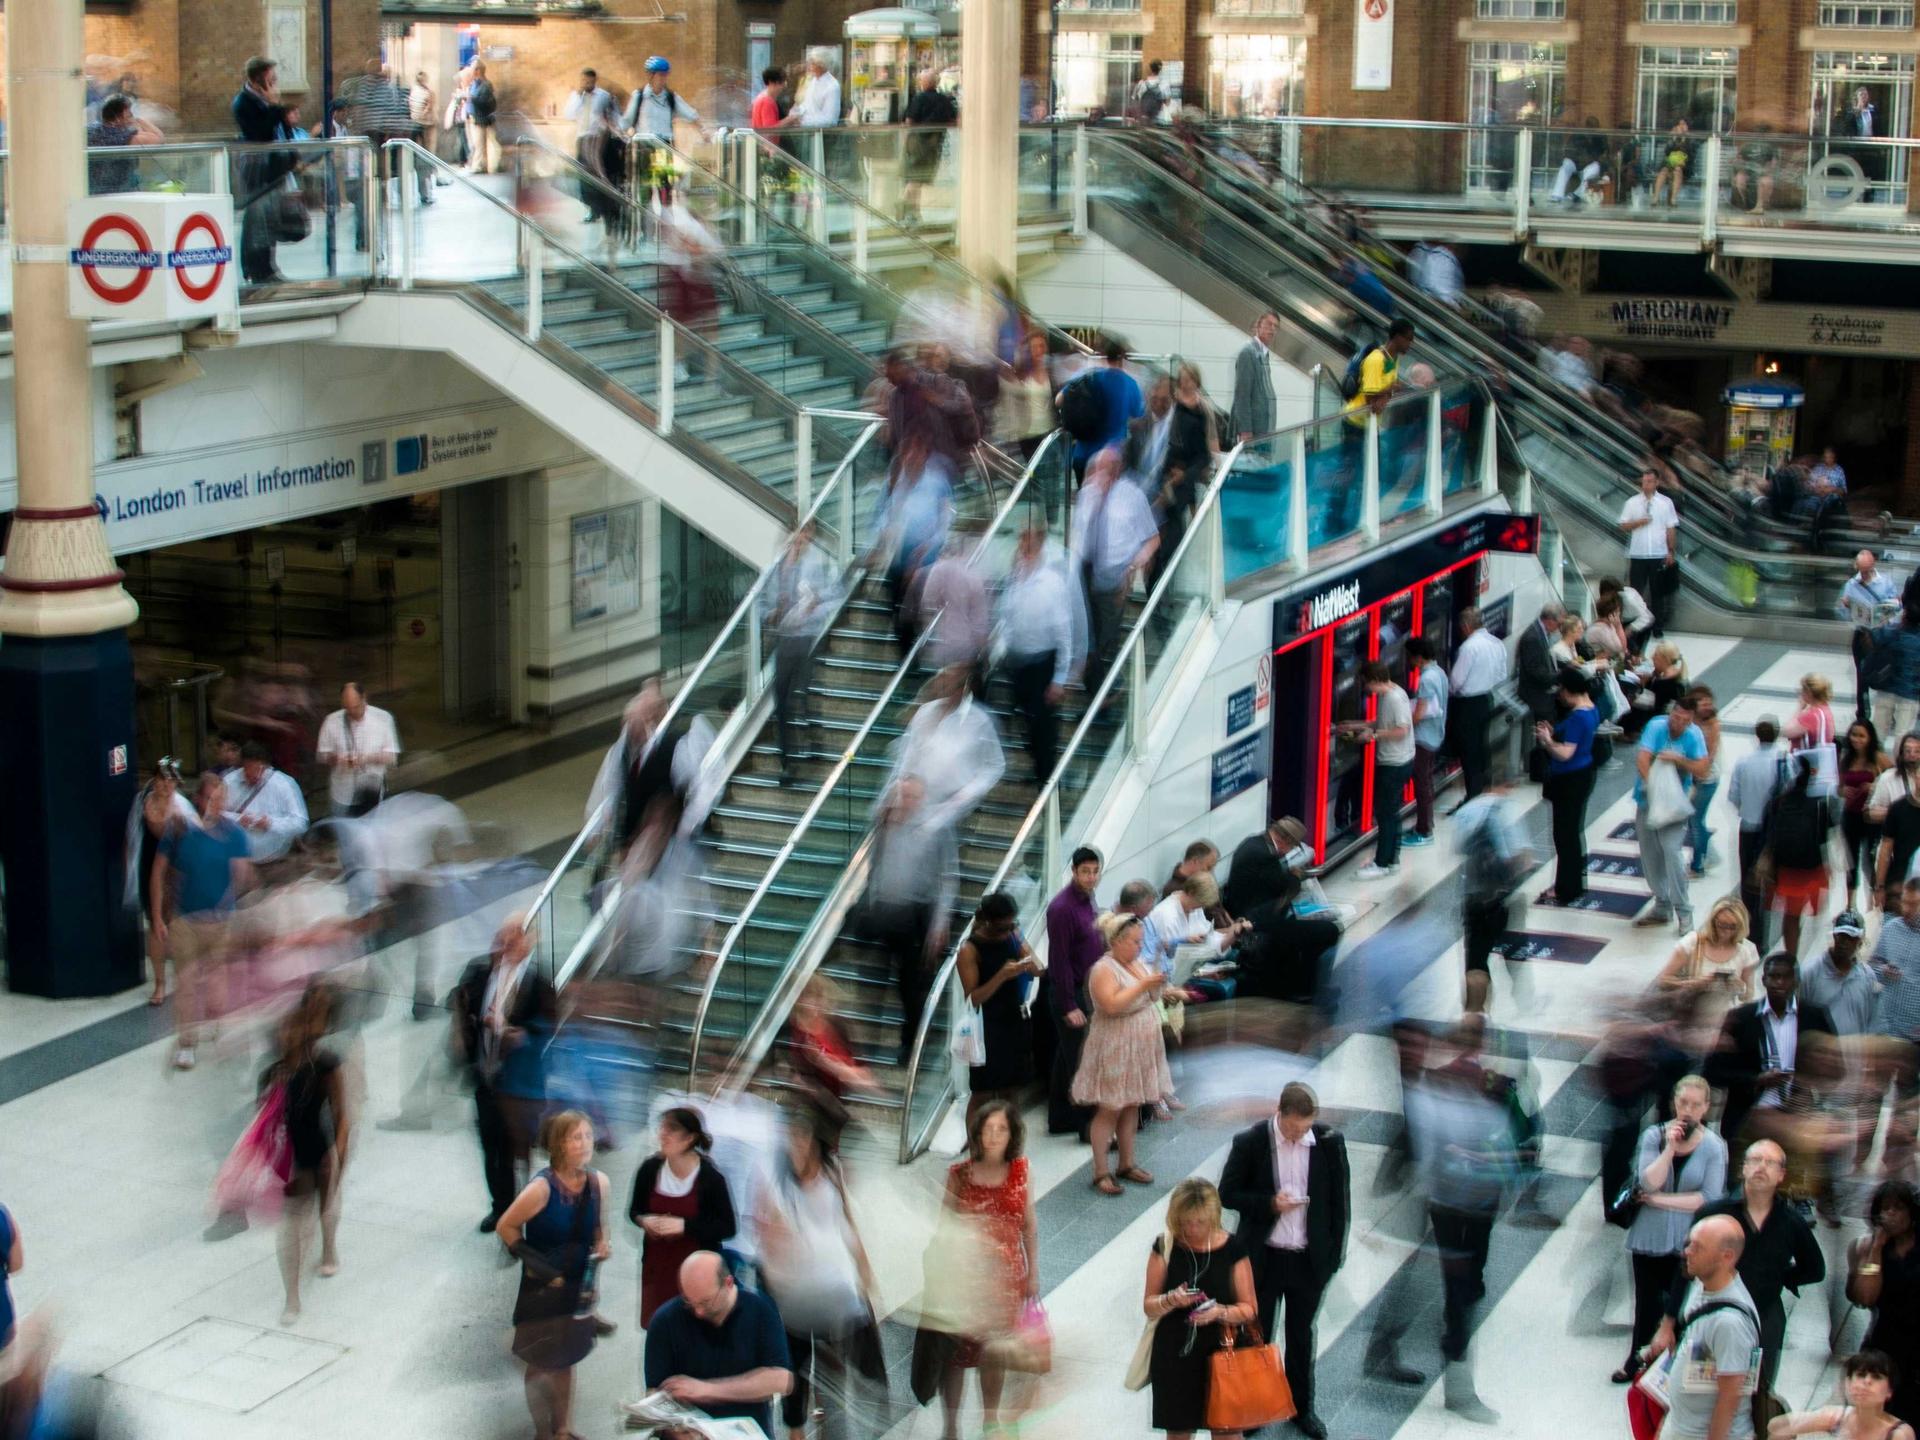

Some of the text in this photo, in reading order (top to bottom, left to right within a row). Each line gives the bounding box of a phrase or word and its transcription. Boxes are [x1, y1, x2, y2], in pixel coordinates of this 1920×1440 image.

[1368, 0, 1384, 15] A
[76, 251, 157, 265] UNDERGROUND
[171, 249, 228, 264] UNDERGROUND
[1612, 299, 1735, 326] MERCHANT
[115, 457, 355, 521] London Travel Information
[1314, 578, 1359, 629] NatWest
